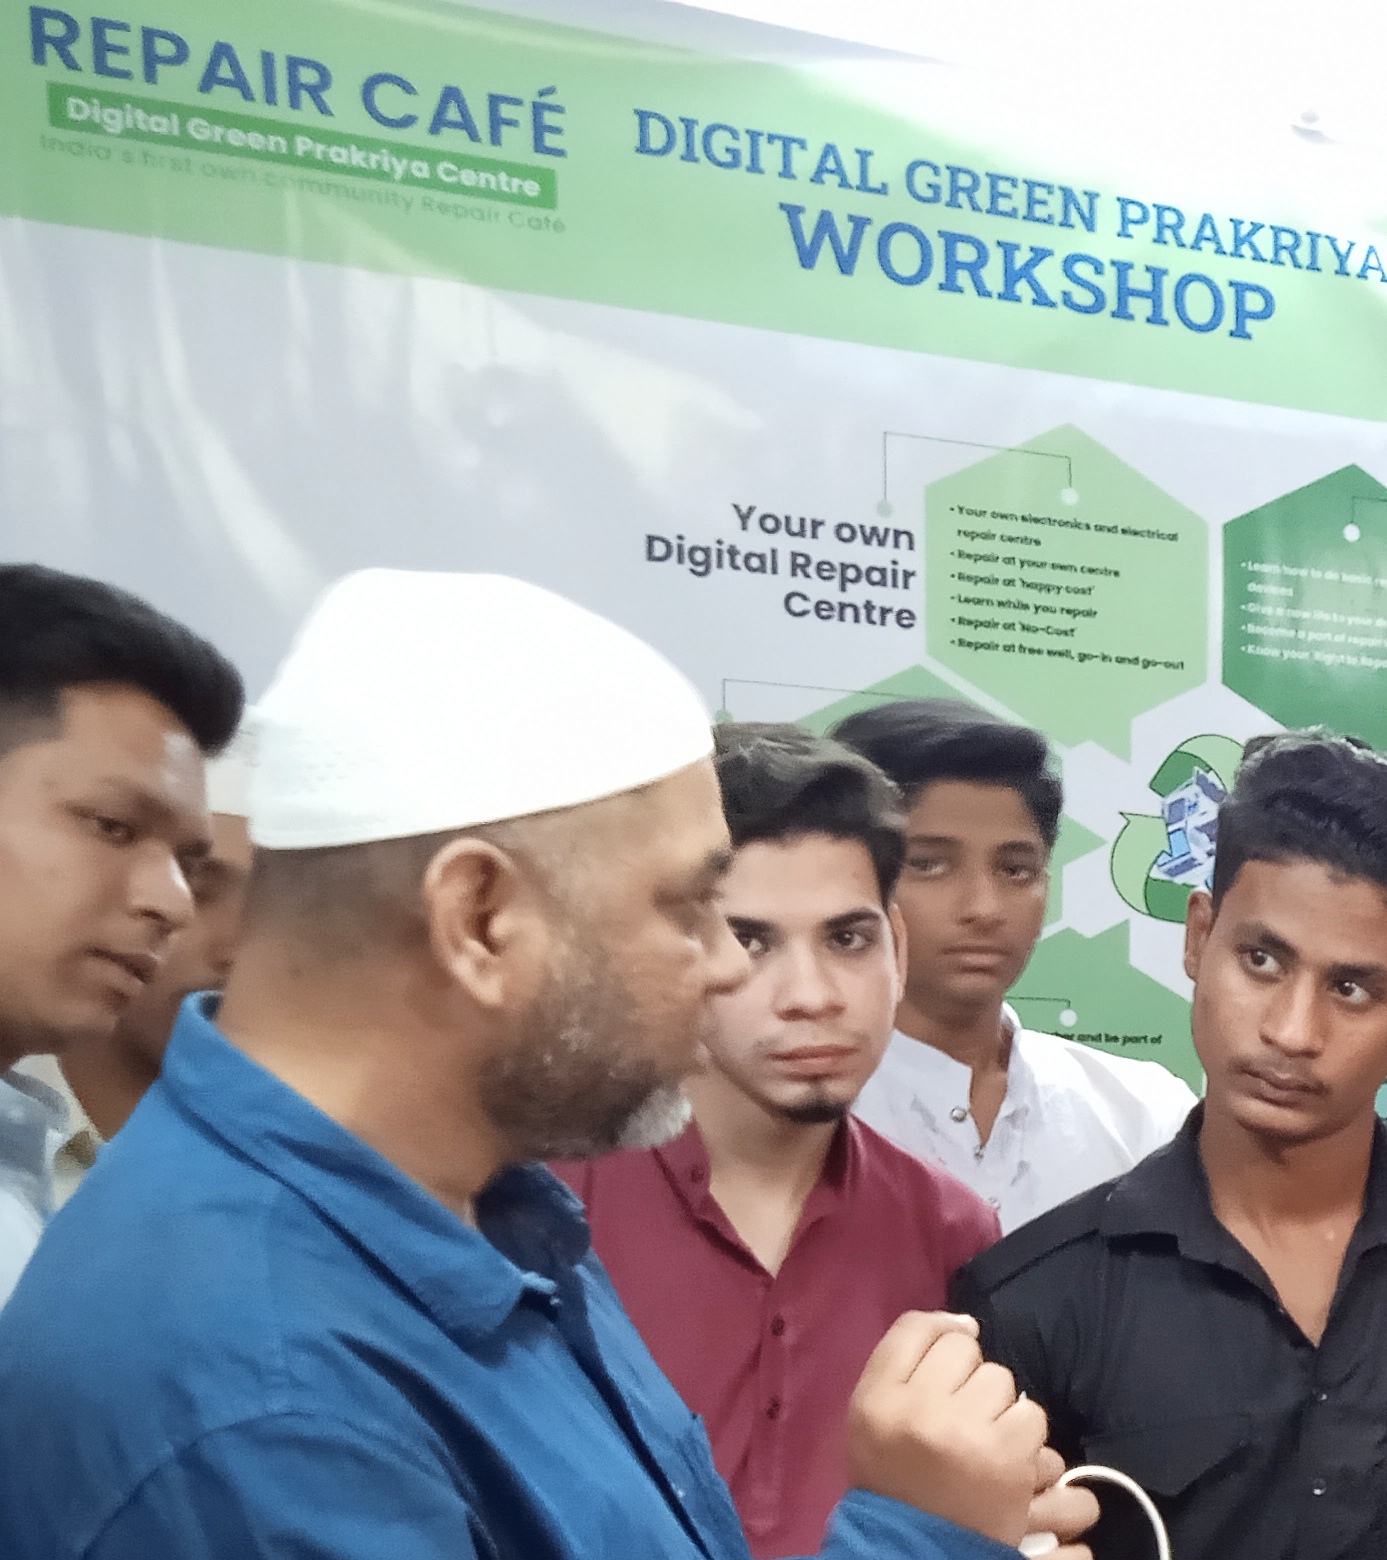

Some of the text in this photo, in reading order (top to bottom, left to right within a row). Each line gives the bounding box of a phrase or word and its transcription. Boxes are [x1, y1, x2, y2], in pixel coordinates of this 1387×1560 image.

[29, 5, 568, 158] REPAIR CAFÉ
[66, 96, 541, 197] Digital Green Prakriya Centre
[632, 108, 888, 197] DIGITAL
[905, 158, 1099, 233] GREEN
[421, 197, 499, 222] Repair
[779, 203, 1276, 340] WORKSHOP
[733, 502, 916, 552] Your own
[957, 505, 988, 518] Your
[990, 510, 1018, 522] own
[1094, 523, 1119, 535] and
[1121, 525, 1179, 542] electrical
[957, 528, 996, 542] repair
[645, 532, 917, 592] Digital Repair
[957, 549, 1000, 564] Repair
[1002, 556, 1016, 566] at
[1018, 557, 1048, 571] your
[1050, 561, 1078, 574] own
[957, 571, 1000, 586] Repair
[1002, 577, 1016, 587] at
[783, 588, 917, 631] Centre
[957, 594, 994, 607] Learn
[1033, 603, 1057, 616] you
[1060, 606, 1098, 620] repair
[957, 616, 1000, 631] Repair
[1002, 622, 1016, 632] at
[957, 638, 1000, 652] Repair
[1002, 643, 1016, 653] at
[1115, 654, 1139, 666] and
[1077, 1033, 1103, 1043] and
[1104, 1032, 1120, 1043] be
[1122, 1034, 1149, 1046] part
[1151, 1034, 1163, 1044] of
